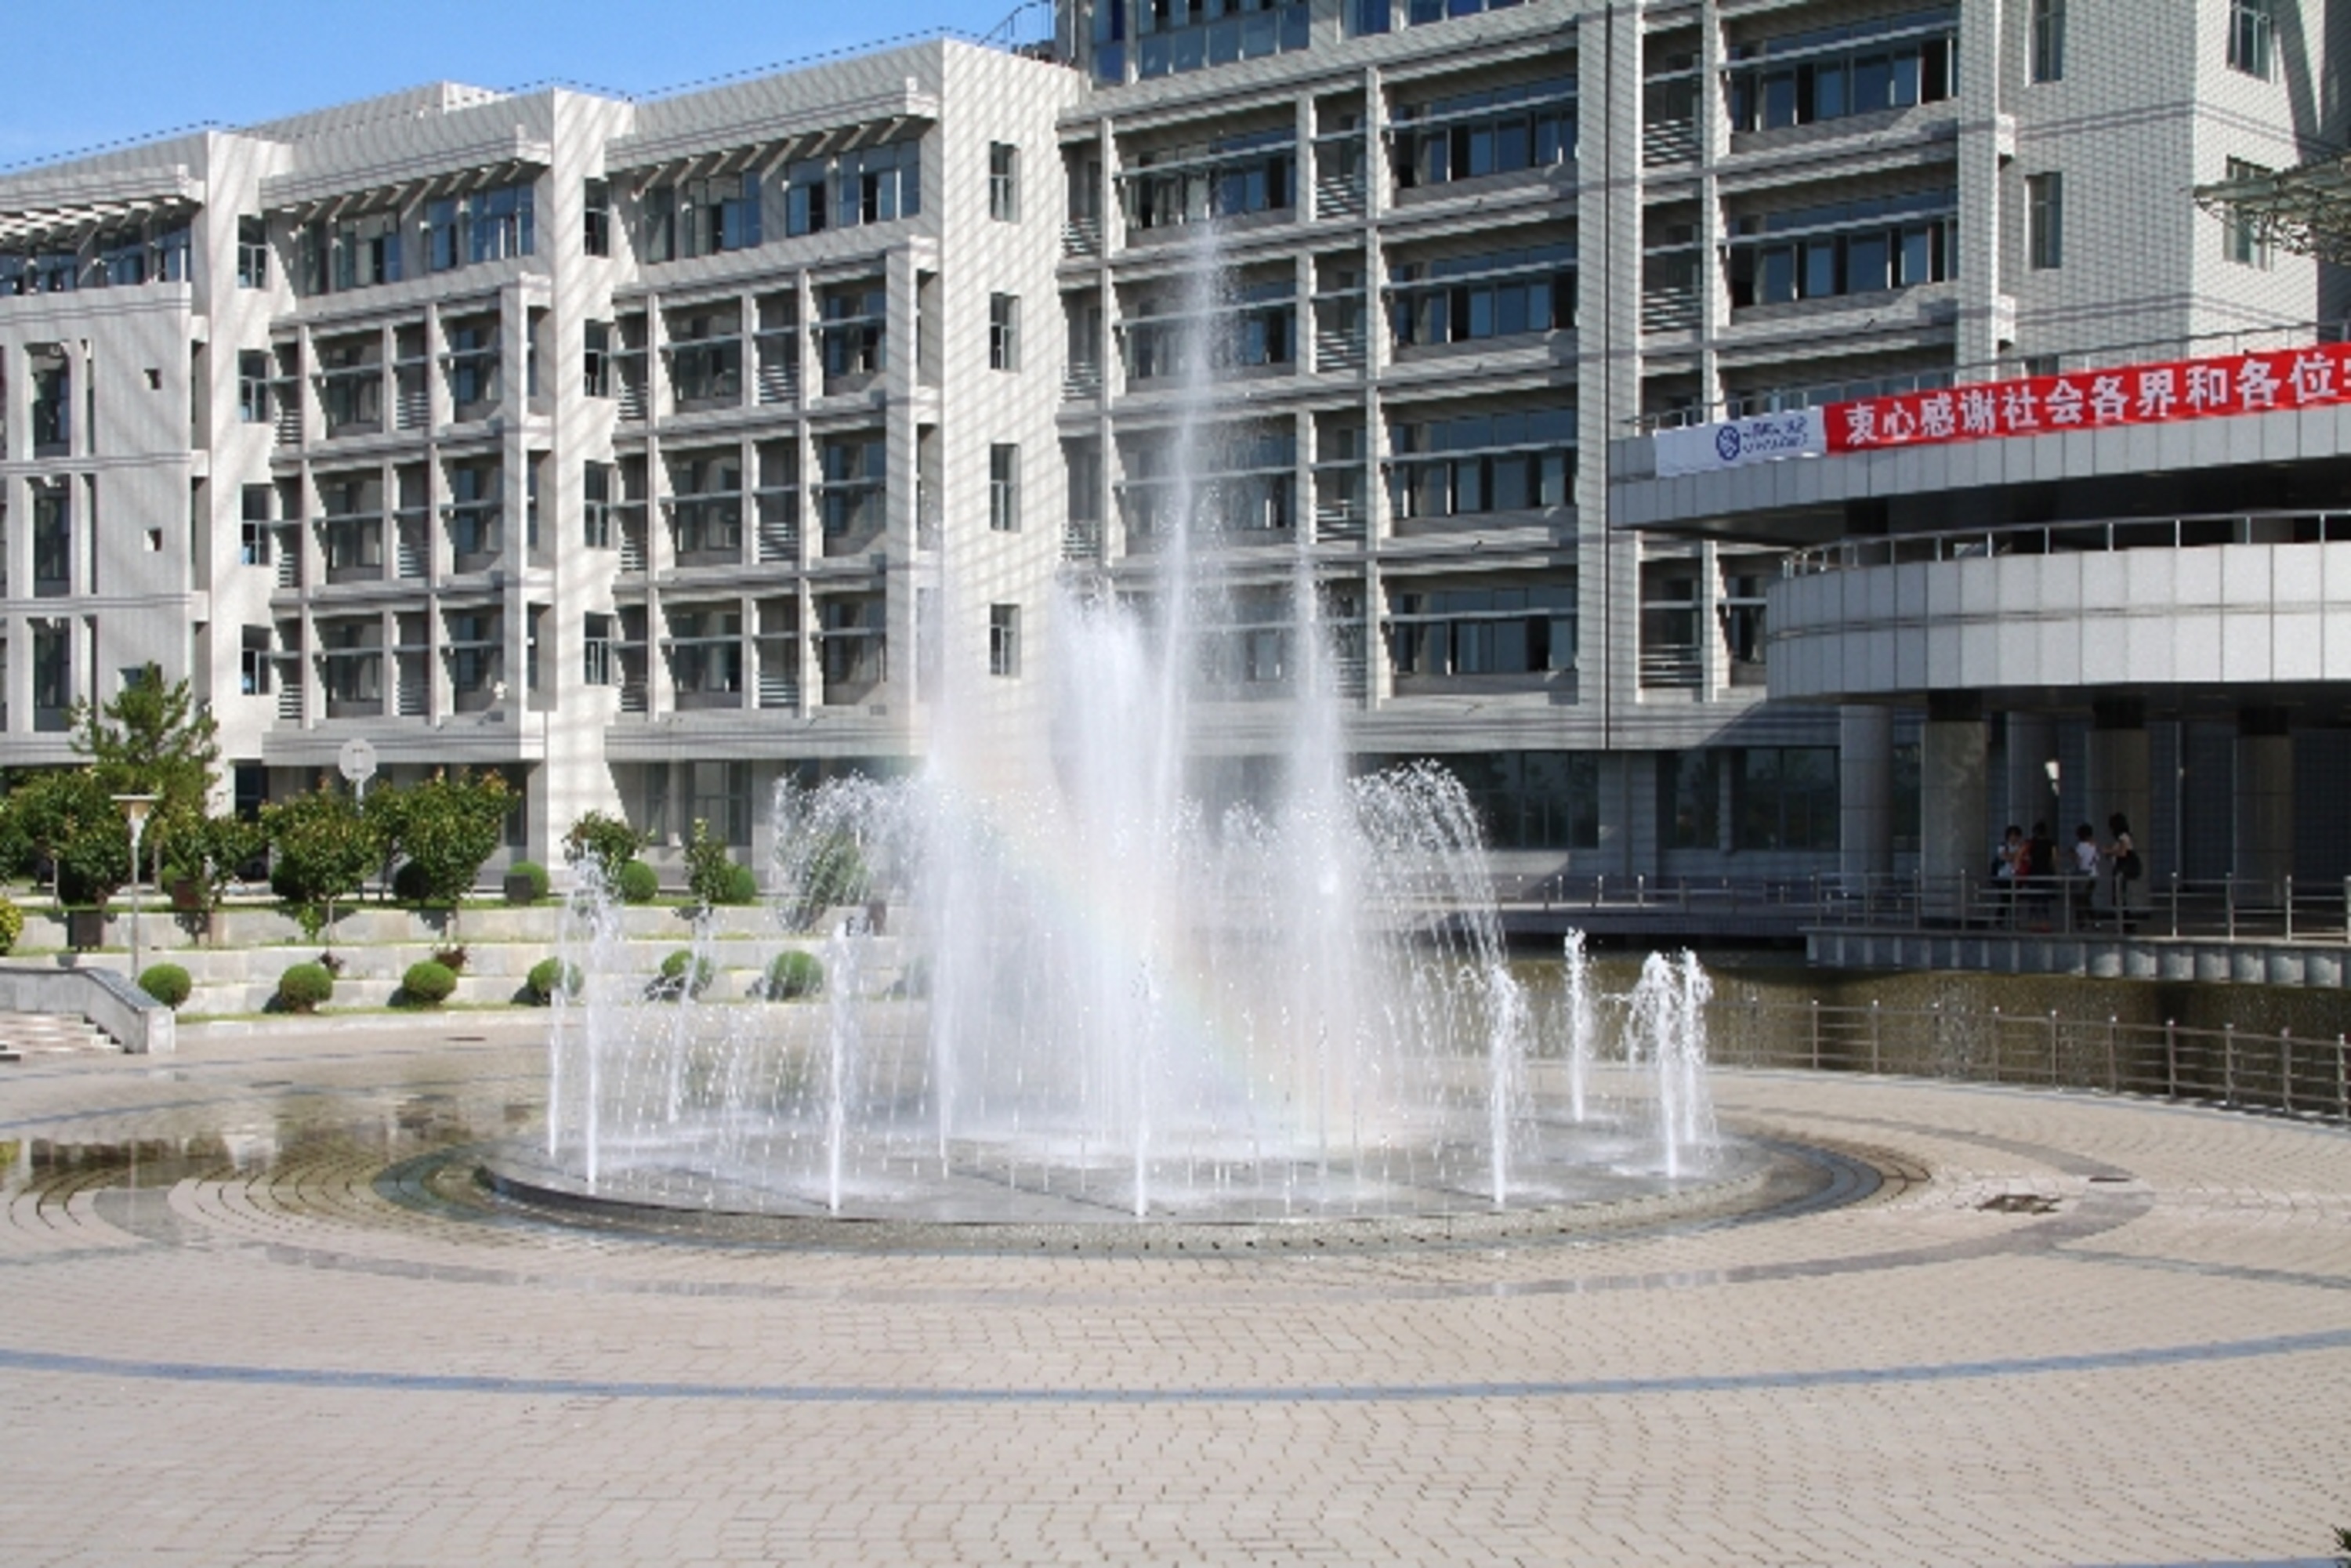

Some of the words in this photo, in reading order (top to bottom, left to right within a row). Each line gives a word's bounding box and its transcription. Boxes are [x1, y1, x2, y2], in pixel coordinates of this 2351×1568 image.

[1844, 353, 2351, 445] 衷心感谢社会各界和各位
